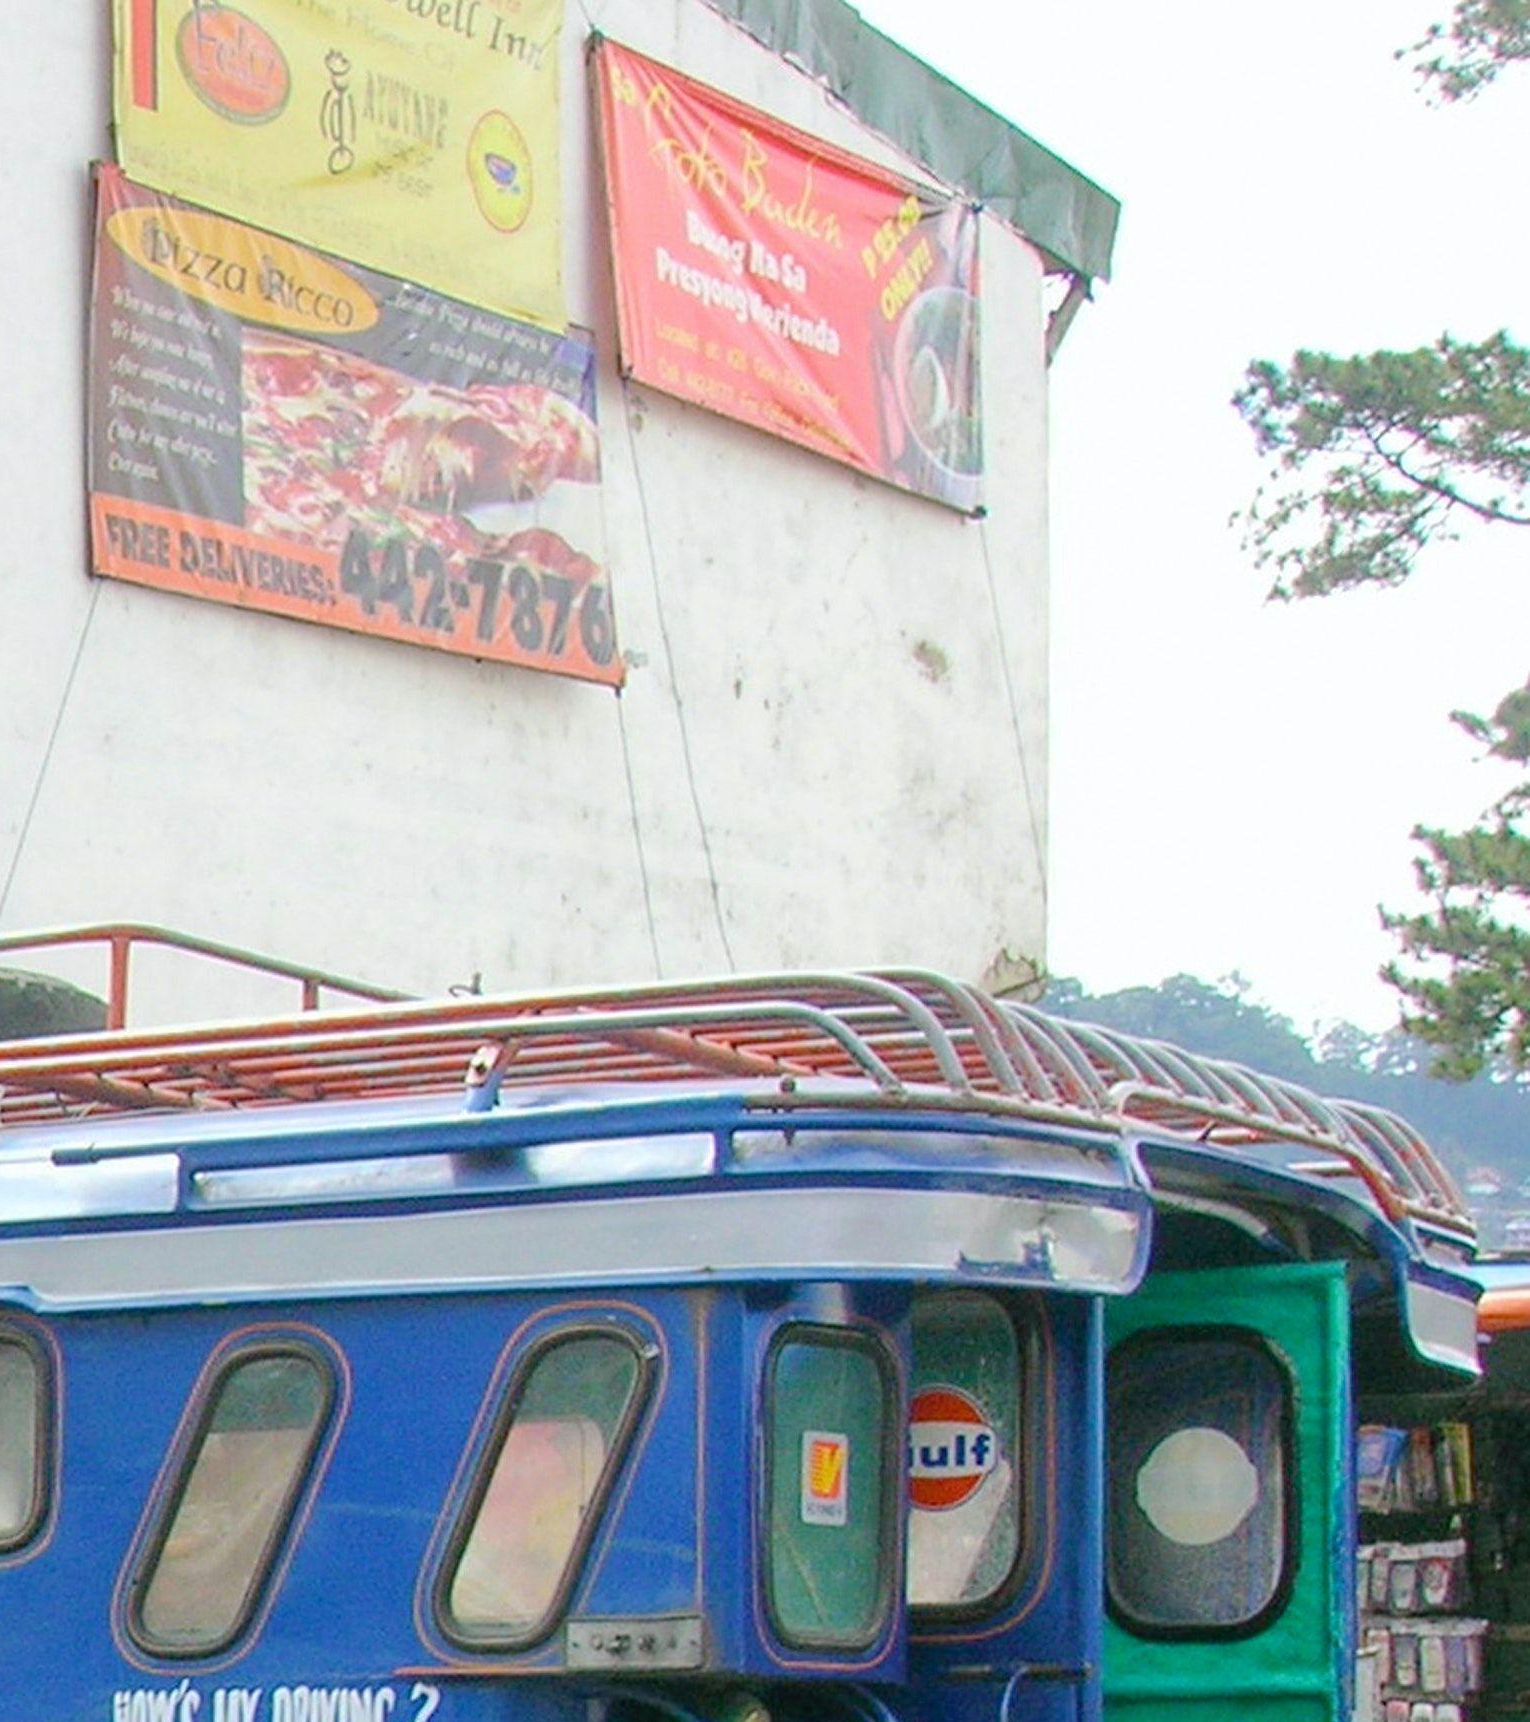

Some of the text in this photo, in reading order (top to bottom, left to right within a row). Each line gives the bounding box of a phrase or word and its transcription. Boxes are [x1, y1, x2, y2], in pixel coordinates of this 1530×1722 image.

[104, 512, 170, 570] FREE
[340, 530, 616, 666] 442-7876
[908, 1433, 992, 1467] ulf
